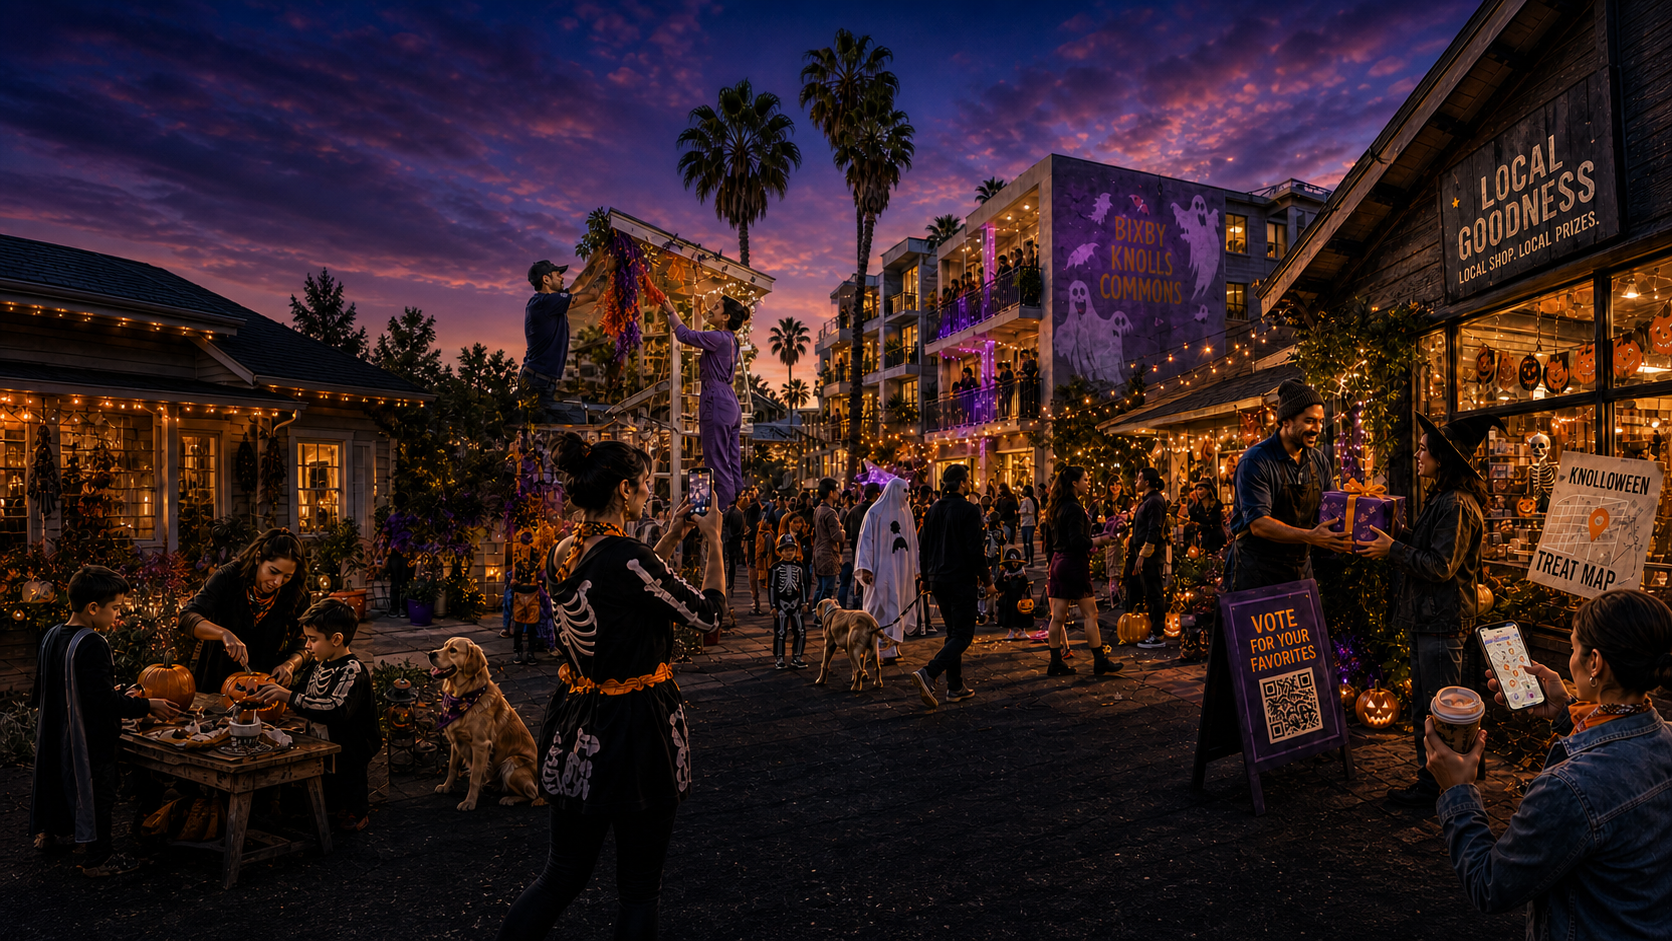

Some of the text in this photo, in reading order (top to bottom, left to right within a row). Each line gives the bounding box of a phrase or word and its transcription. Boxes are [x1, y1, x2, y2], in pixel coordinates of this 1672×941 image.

[1481, 134, 1563, 211] LOCAL
[1458, 160, 1595, 261] GOODNESS
[1115, 215, 1167, 247] BIXBY
[1459, 210, 1600, 284] LOCAL SHOP. LOCAL PRIZES.
[1111, 245, 1173, 276] KNOLLS
[1100, 273, 1182, 305] COMMONS
[1568, 467, 1651, 495] KNOLLOWEEN
[1536, 550, 1616, 591] TREAT MAP
[1250, 608, 1298, 634] VOTE
[1250, 628, 1311, 654] FOR YOUR
[1250, 644, 1317, 673] FAVORITES
